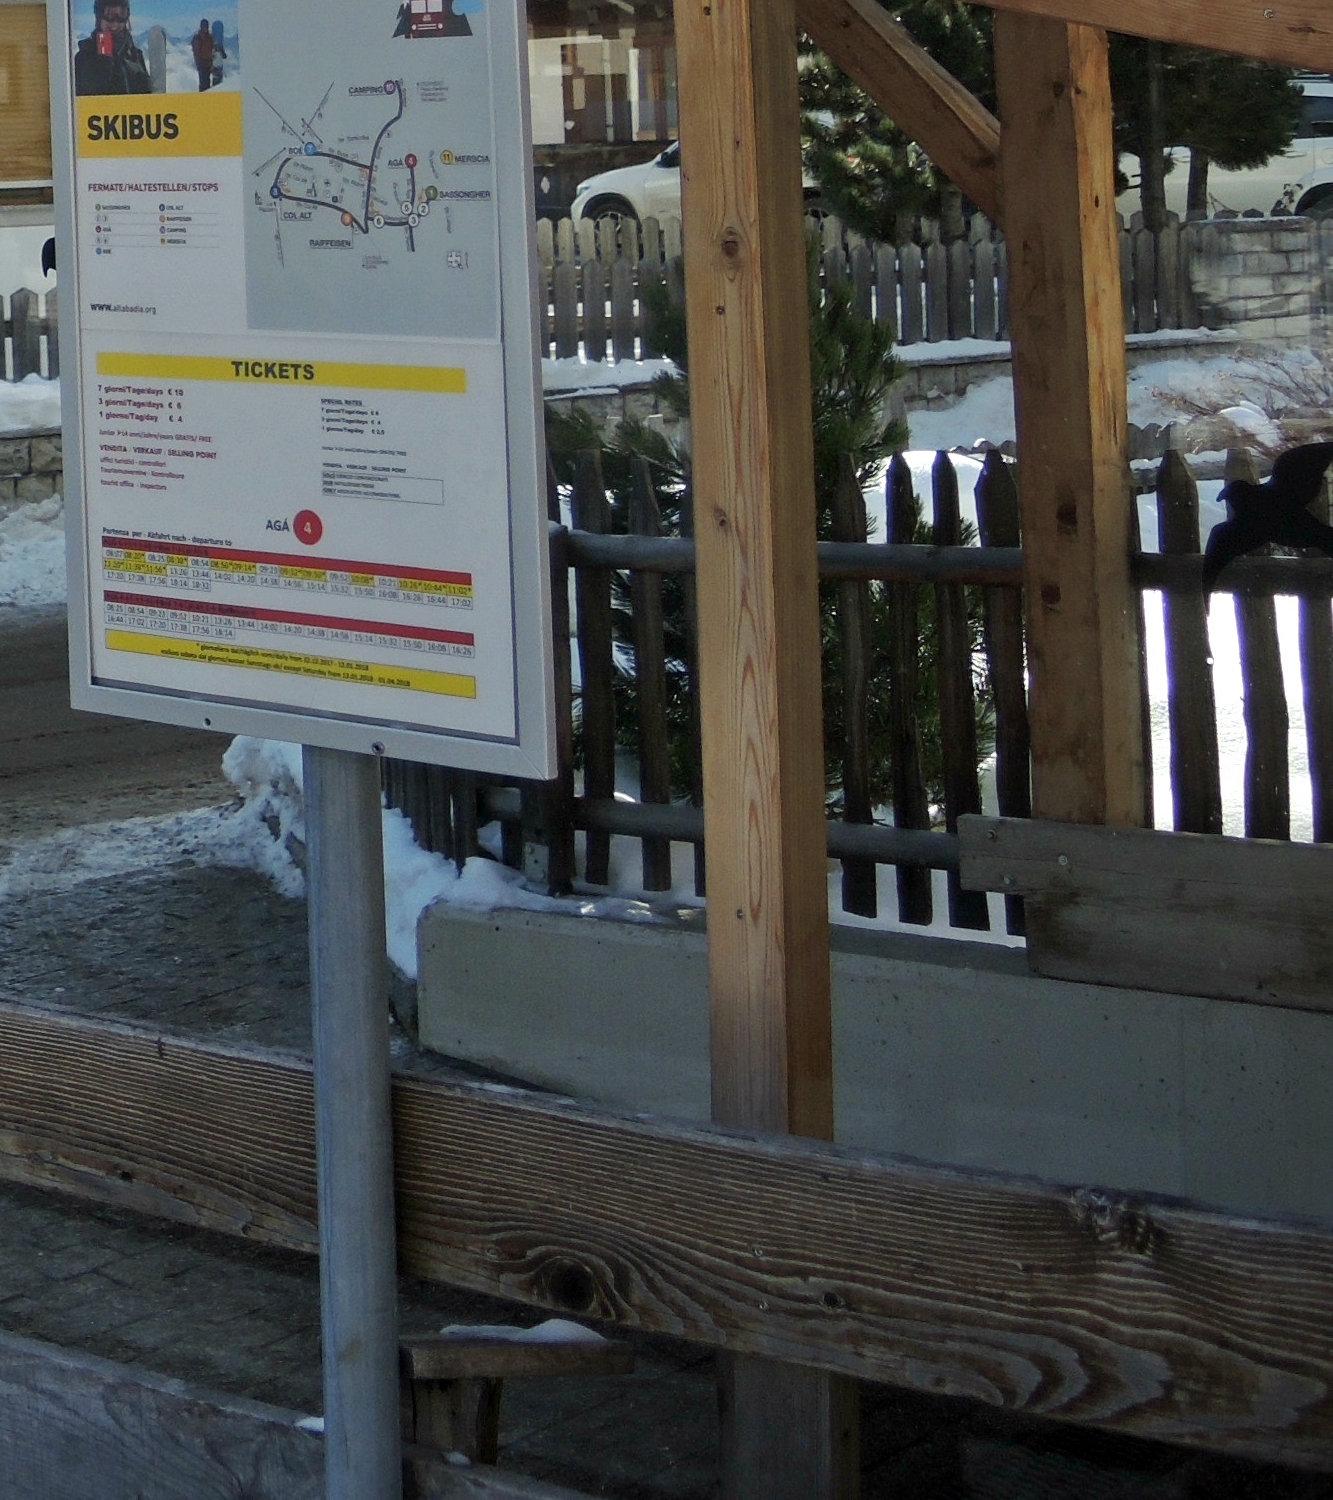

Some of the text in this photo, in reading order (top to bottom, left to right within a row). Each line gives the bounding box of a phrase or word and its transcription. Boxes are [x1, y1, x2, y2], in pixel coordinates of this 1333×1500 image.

[348, 86, 383, 94] CAMPING
[87, 113, 180, 141] SKIBUS
[231, 361, 315, 381] TICKETS
[303, 521, 312, 534] 4
